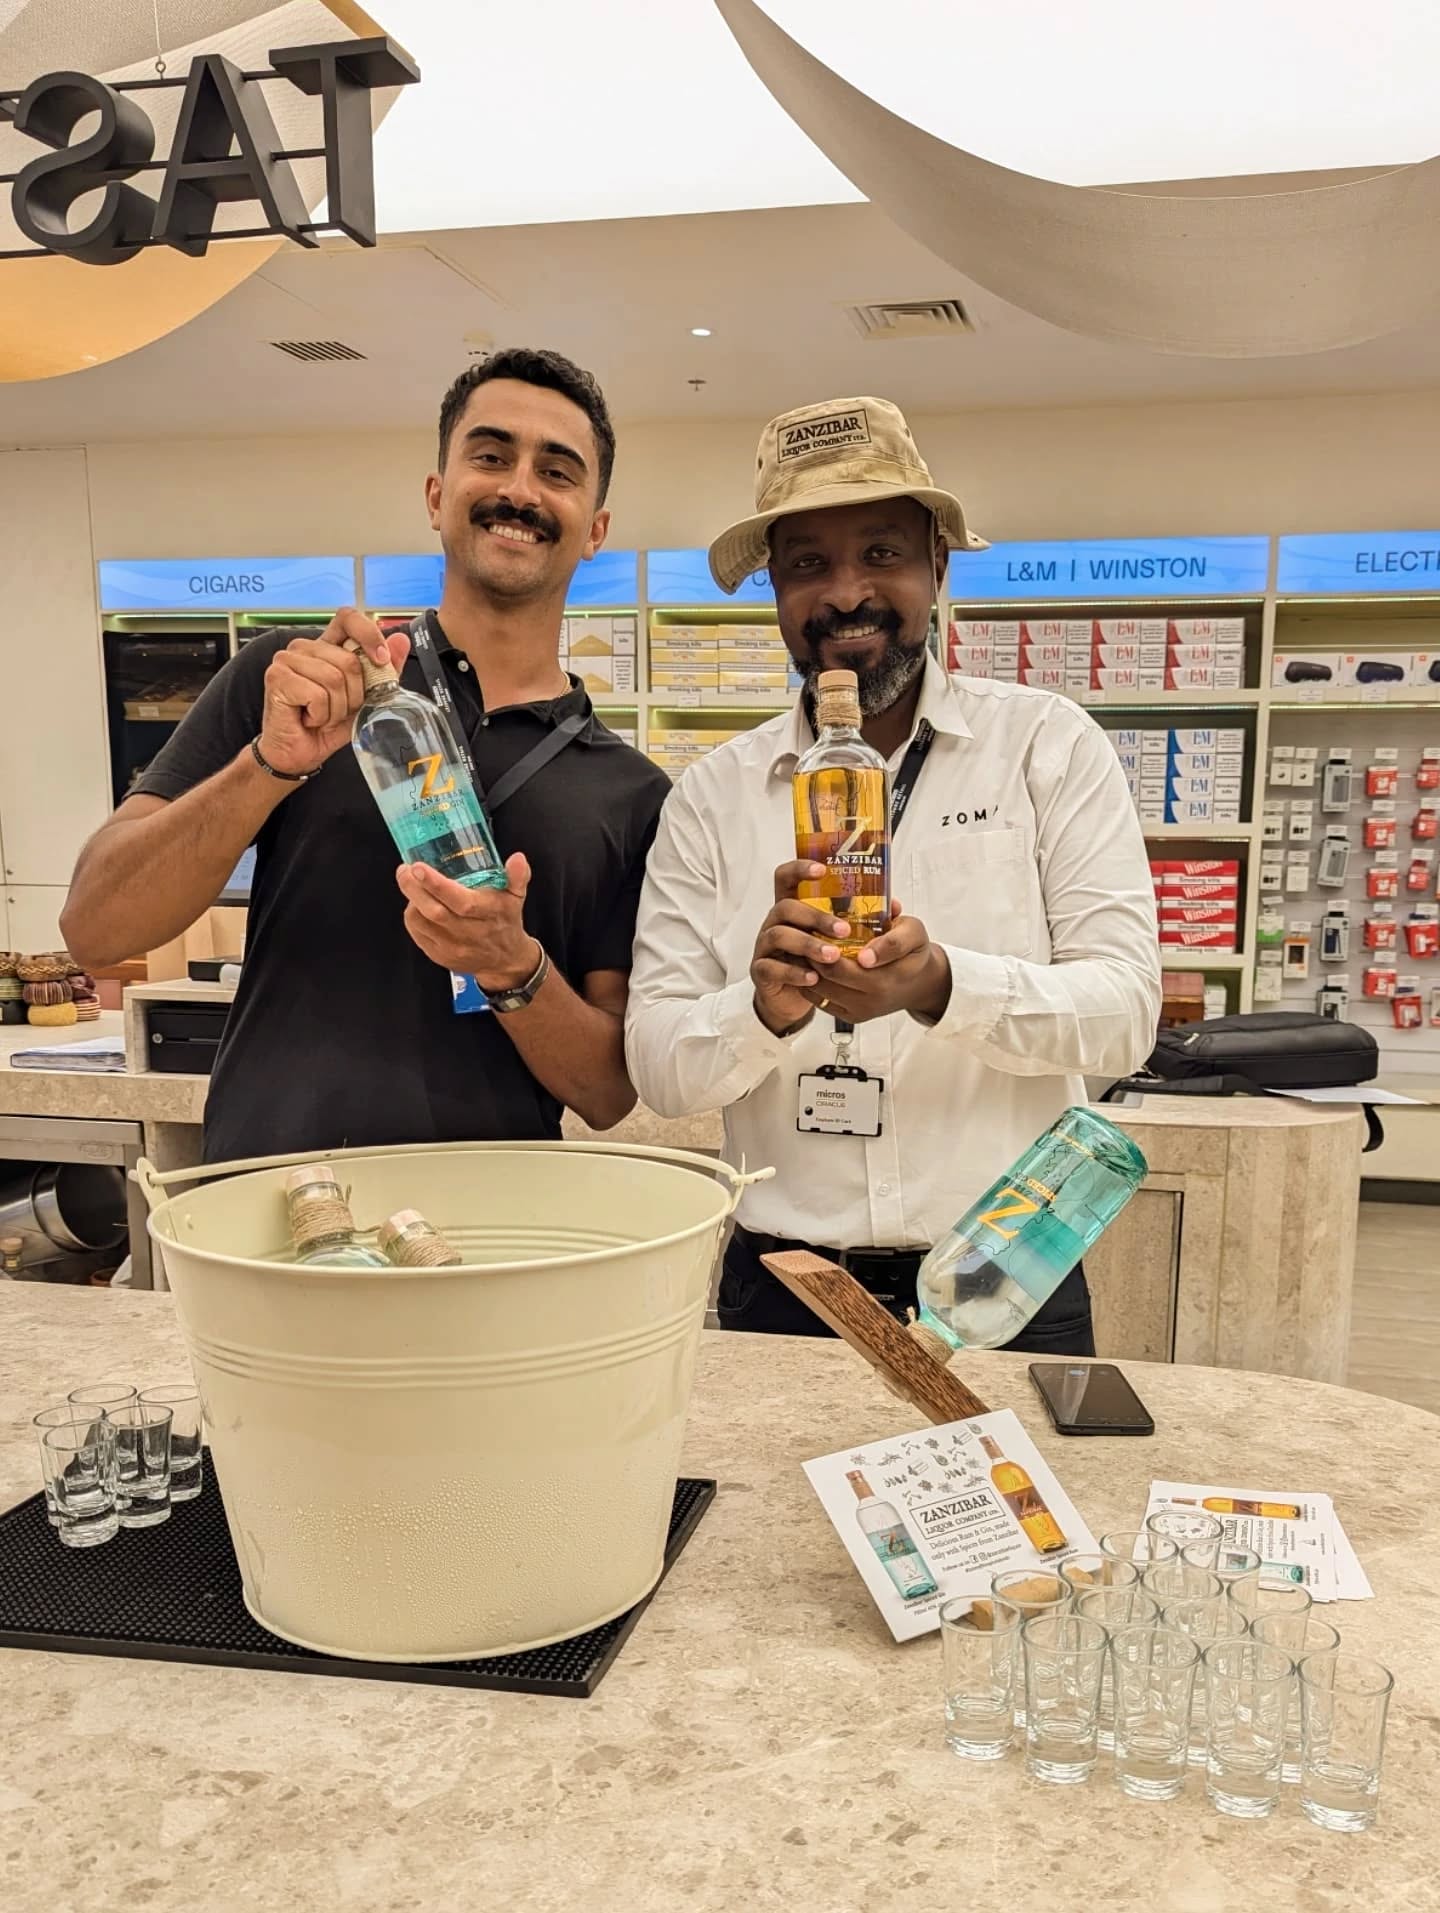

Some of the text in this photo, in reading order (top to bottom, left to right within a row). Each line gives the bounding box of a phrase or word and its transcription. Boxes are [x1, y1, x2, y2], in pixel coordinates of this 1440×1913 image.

[785, 416, 863, 446] ZANZIBAR
[781, 443, 811, 458] LIQUOR
[812, 434, 853, 449] COMPANY
[1006, 561, 1057, 582] L&M
[1089, 556, 1207, 580] WINSTON
[189, 575, 265, 594] CIGARS
[407, 753, 456, 799] Z
[836, 815, 874, 857] Z
[826, 855, 883, 866] ZANZIBAR
[863, 866, 882, 876] RUM
[1184, 860, 1224, 876] Winston
[1182, 885, 1223, 900] Winston
[1182, 908, 1223, 922] Winston
[1180, 931, 1222, 946] Winston
[816, 1088, 846, 1100] micros
[976, 1187, 1040, 1241] Z
[920, 1495, 993, 1524] ZANZIBAR
[925, 1521, 955, 1536] LIQUOR
[954, 1510, 989, 1527] COMPANY
[929, 1535, 958, 1550] Delicious
[959, 1530, 973, 1541] Rum
[980, 1524, 994, 1536] Gin,
[994, 1520, 1010, 1532] made
[931, 1549, 946, 1561] only
[978, 1534, 993, 1547] from
[994, 1528, 1020, 1541] Zanzibar
